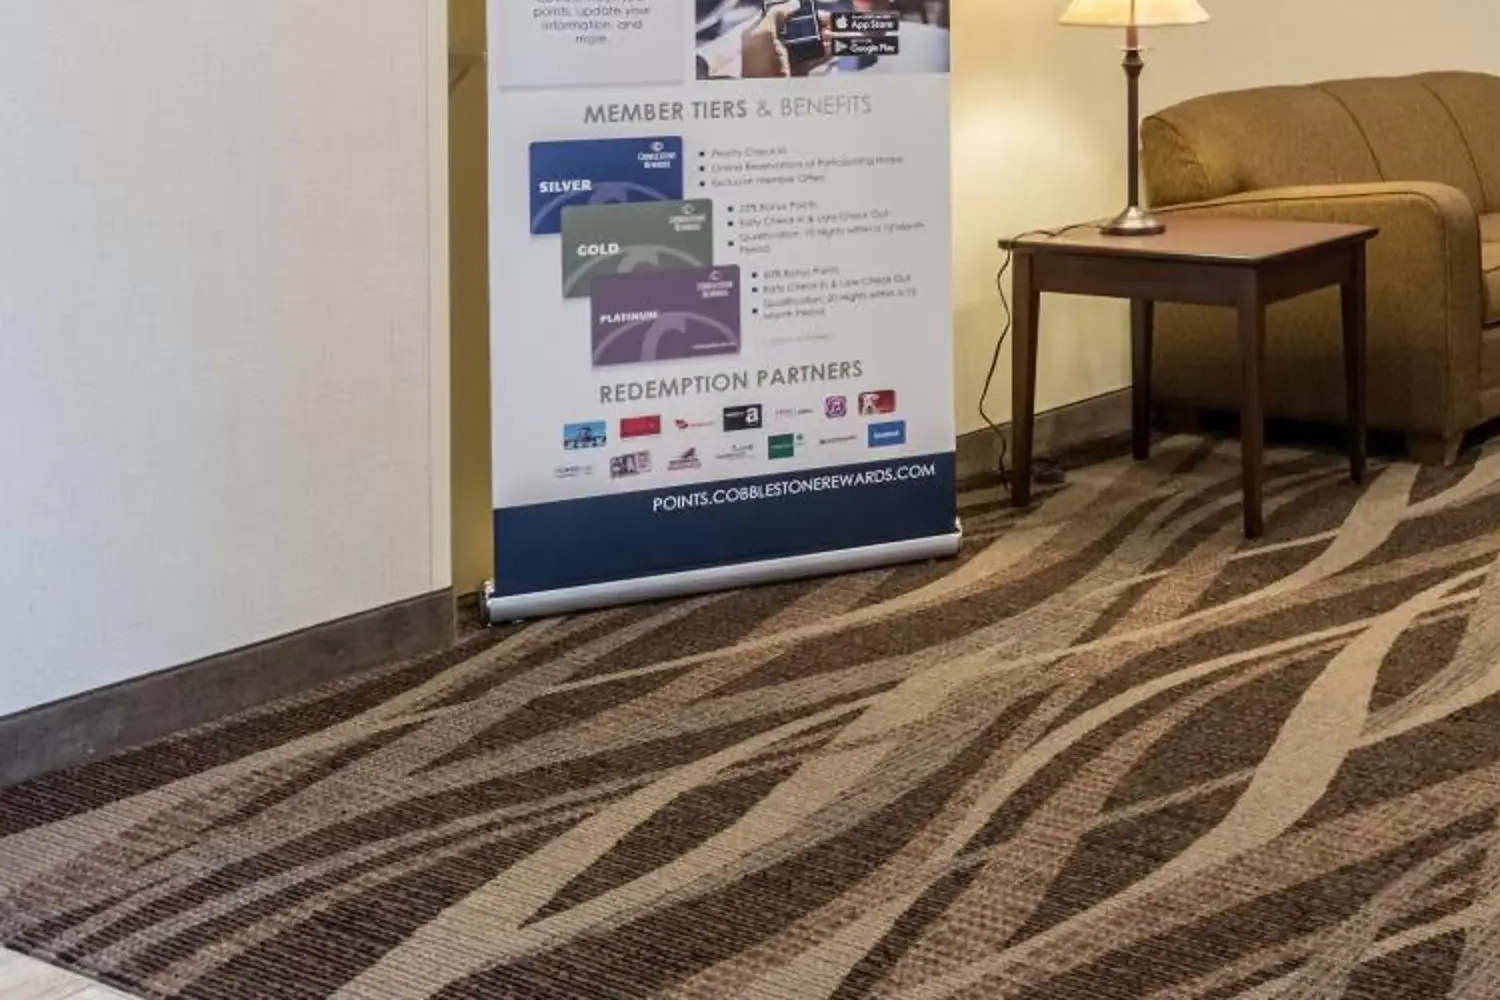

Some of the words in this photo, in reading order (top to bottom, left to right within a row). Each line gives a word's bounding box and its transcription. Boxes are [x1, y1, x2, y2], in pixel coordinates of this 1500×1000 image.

[584, 100, 684, 124] MEMBER
[691, 99, 747, 120] TIERS
[756, 101, 772, 119] &
[781, 94, 872, 117] BENEFITS
[539, 179, 593, 193] SILVER
[576, 242, 620, 256] GOLD
[599, 310, 659, 324] PLATINUM
[599, 371, 748, 404] REDEMPTION
[757, 359, 863, 389] PARTNERS
[652, 463, 936, 513] POINTS.COBBLESTONEREWARDS.COM
